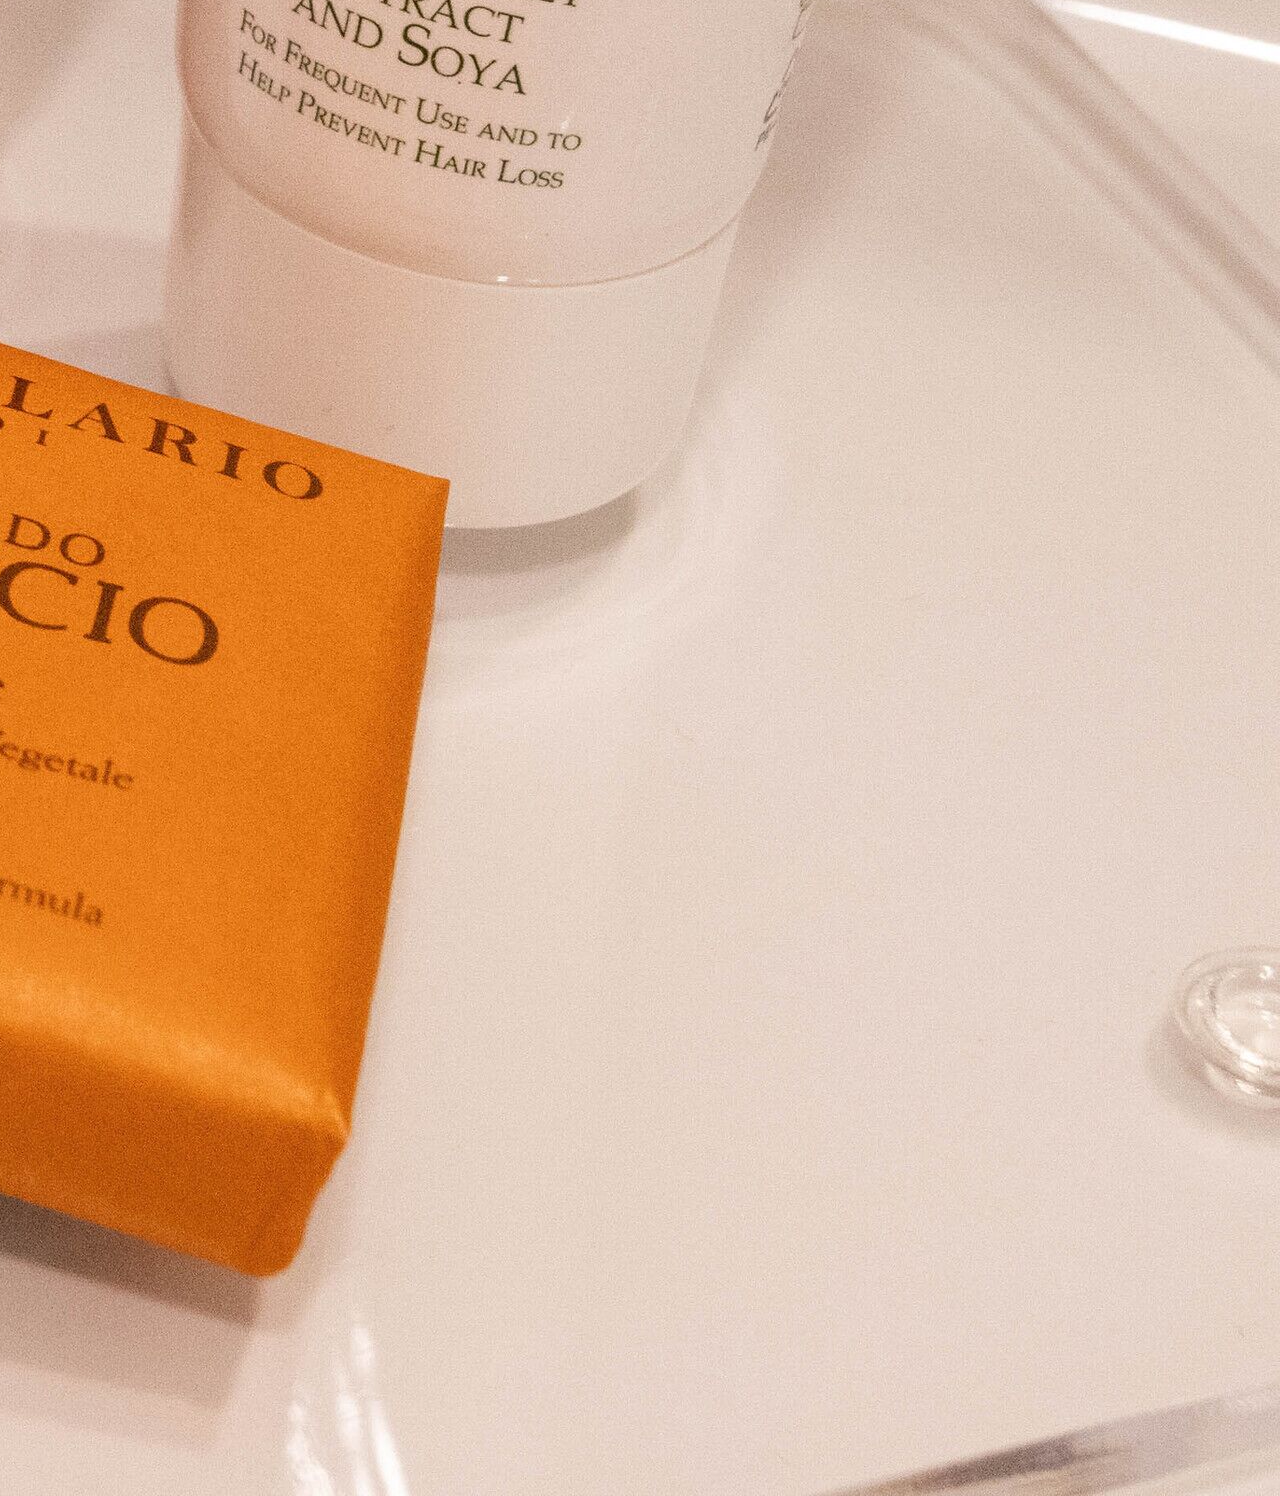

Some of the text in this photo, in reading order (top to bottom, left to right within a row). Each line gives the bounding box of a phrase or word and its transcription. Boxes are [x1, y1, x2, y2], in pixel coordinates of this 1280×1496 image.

[238, 50, 565, 190] HELP PREVENT HAIR LOSS
[239, 7, 582, 151] FOR FREQUENT USE AND TO
[397, 23, 527, 95] SOYA
